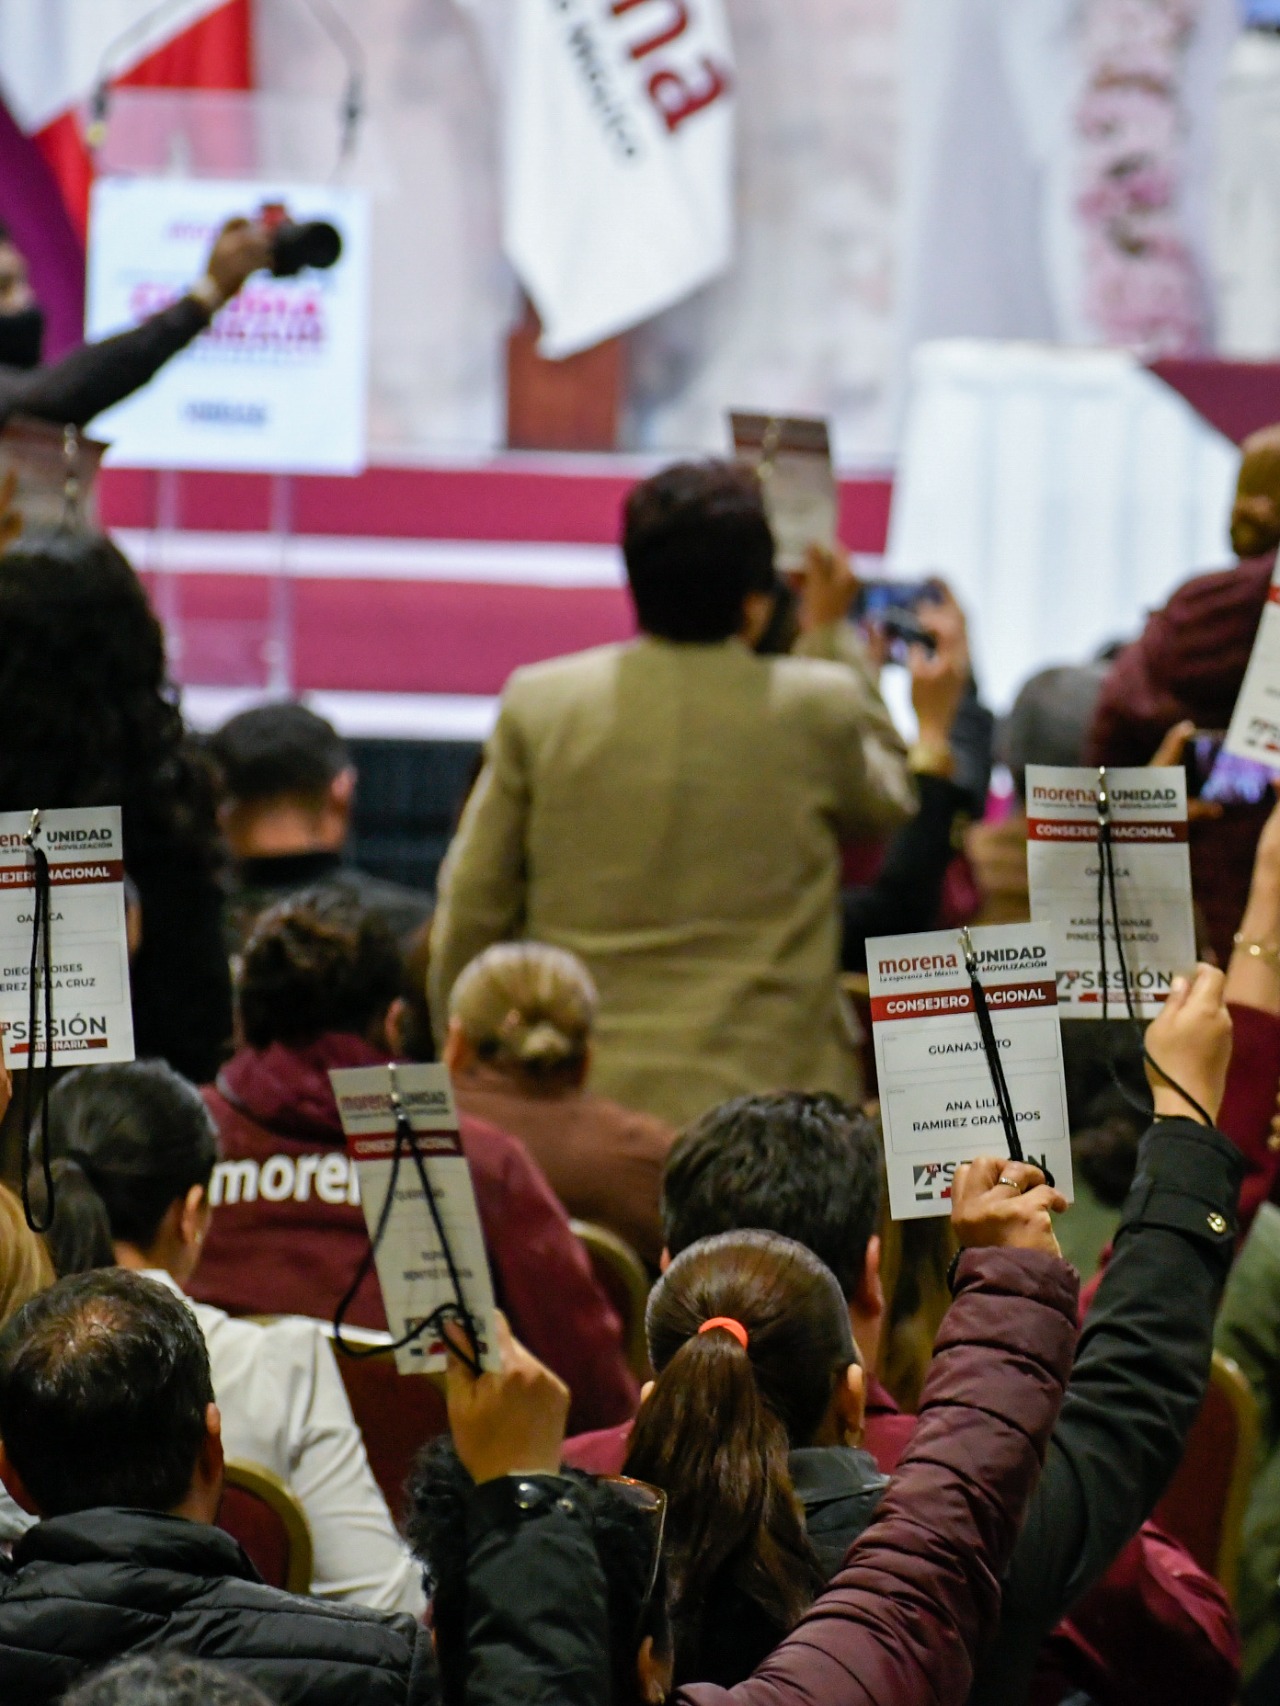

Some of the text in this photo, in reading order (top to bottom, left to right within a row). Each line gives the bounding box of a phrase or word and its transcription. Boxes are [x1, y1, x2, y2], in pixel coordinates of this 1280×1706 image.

[1033, 786, 1176, 802] morena UNIDAD
[46, 829, 113, 843] UNIDAD
[1036, 824, 1175, 838] CONSEJER NACIONAL
[1085, 868, 1130, 877] OACA
[17, 912, 64, 923] OACA
[879, 946, 1046, 974] morena UNIDAD
[982, 961, 1047, 972] MOVILIZACIÓN
[4, 967, 36, 976] DIEG
[1081, 967, 1173, 989] SESIÓN
[0, 982, 28, 992] EREZ
[66, 978, 96, 988] CRUZ
[886, 988, 1047, 1015] CONSEJERO ACIONAL
[12, 1012, 107, 1040] SESIÓN
[34, 1040, 88, 1052] RINARIA
[928, 1039, 1011, 1055] GUANAJUTO
[945, 1100, 971, 1112] ANA
[913, 1111, 1041, 1132] RAMIREZ GRANDOS
[208, 1152, 361, 1206] more
